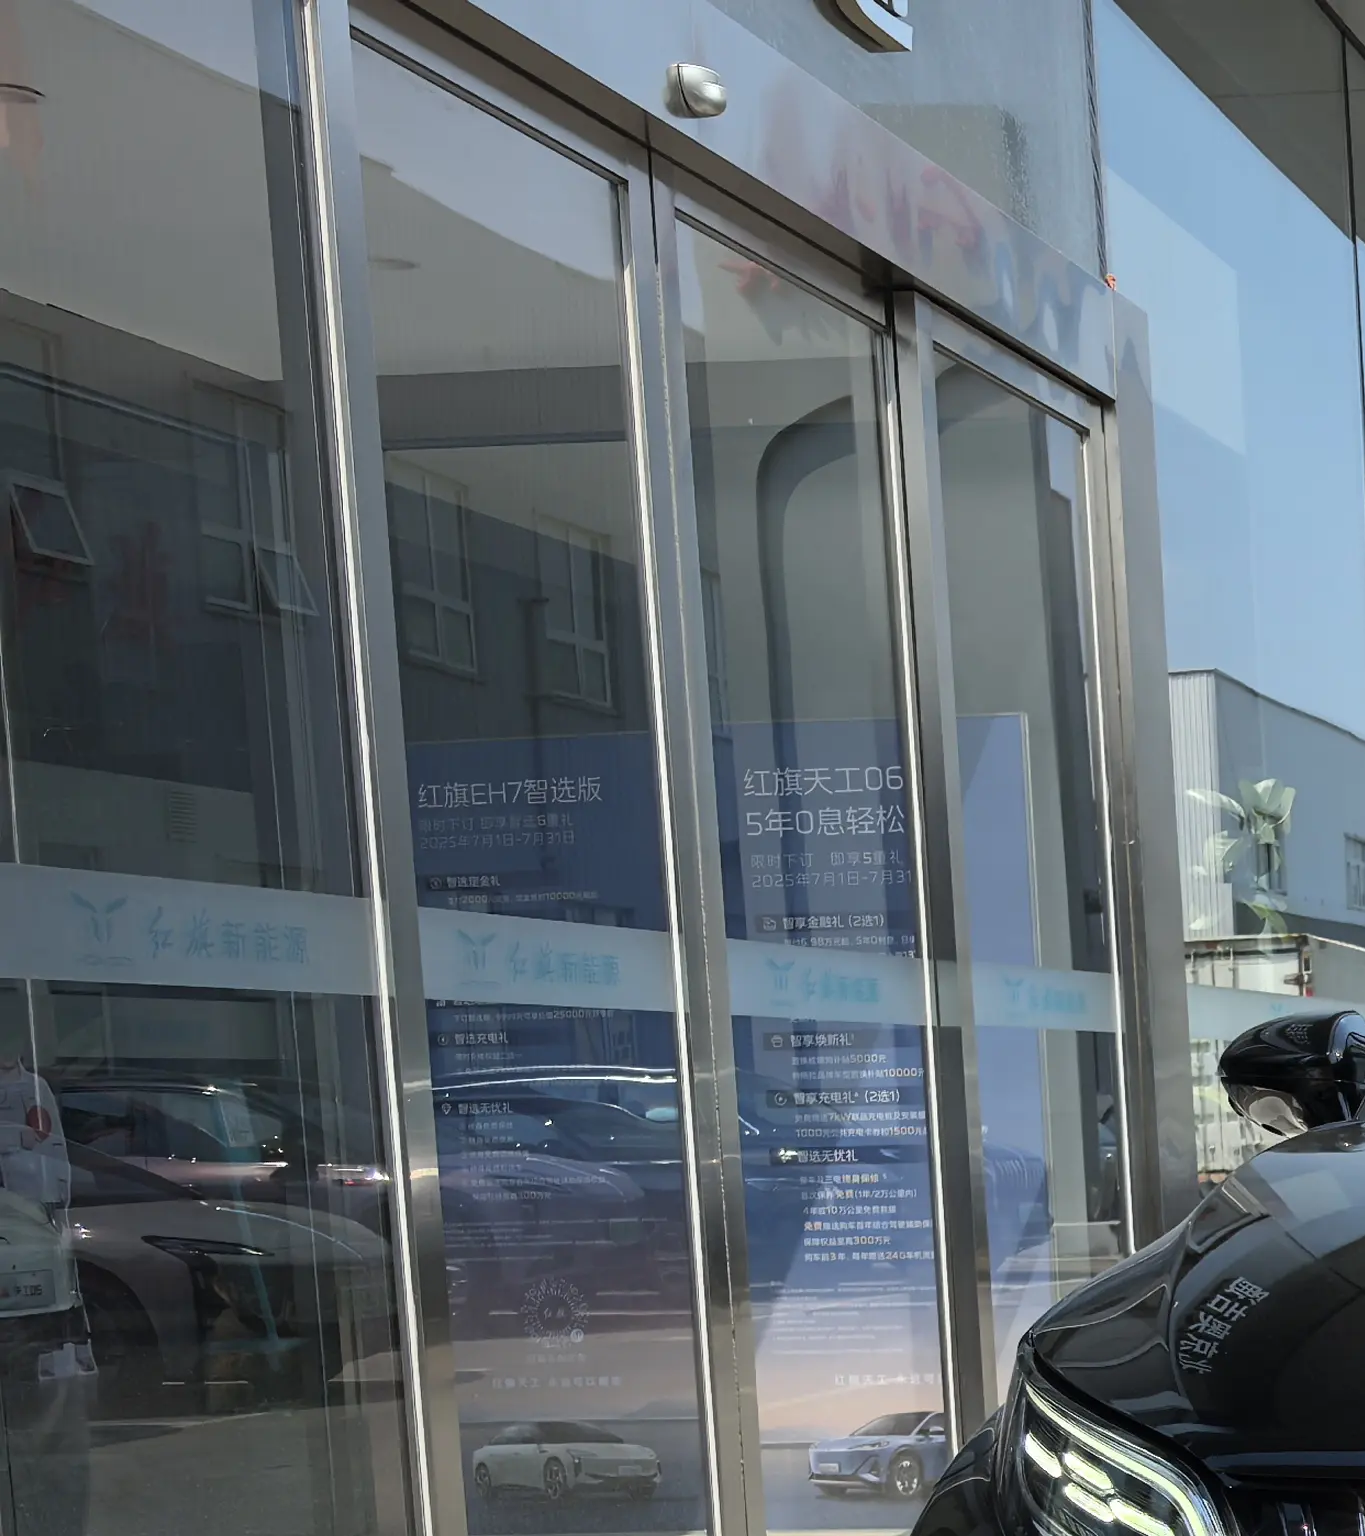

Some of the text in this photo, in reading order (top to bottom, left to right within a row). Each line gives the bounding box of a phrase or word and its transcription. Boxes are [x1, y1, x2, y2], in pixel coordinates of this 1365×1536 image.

[418, 775, 603, 809] 红旗EH7智选版
[744, 766, 904, 796] 红旗天工06
[746, 804, 905, 837] 5年0息轻松
